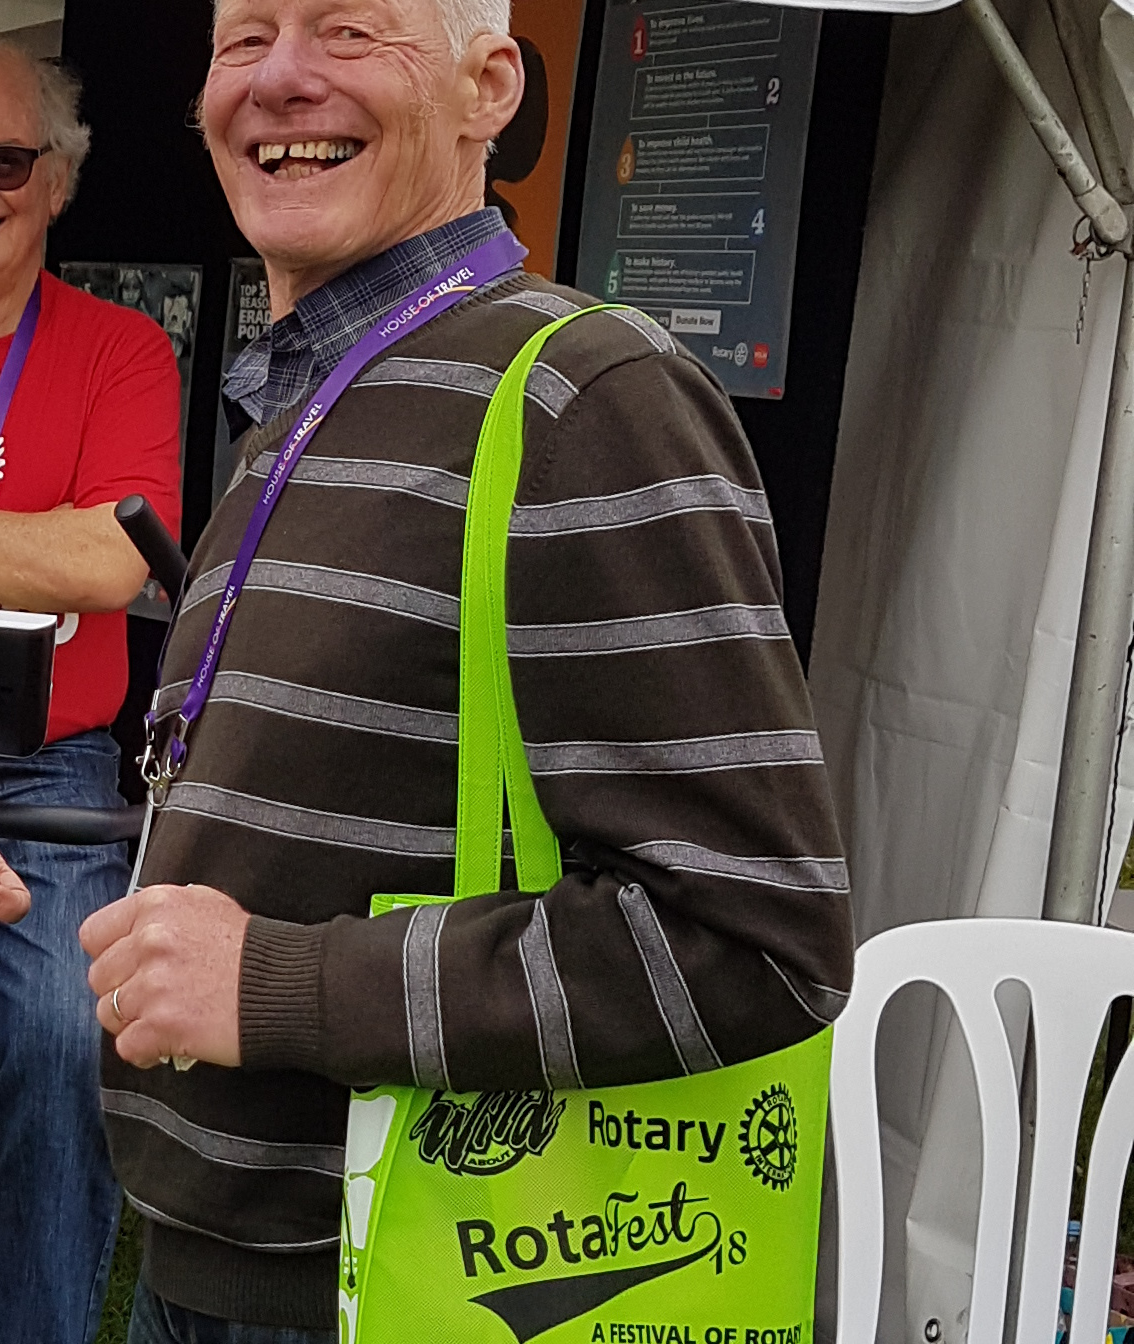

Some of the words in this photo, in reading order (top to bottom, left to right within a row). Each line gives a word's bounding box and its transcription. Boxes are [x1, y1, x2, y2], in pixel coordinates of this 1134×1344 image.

[634, 30, 644, 54] 1
[767, 77, 780, 104] 2
[621, 153, 631, 177] 3
[751, 208, 765, 235] 4
[240, 285, 257, 296] TOP
[259, 280, 267, 297] 5
[608, 270, 618, 294] 5
[239, 297, 269, 309] REASO
[379, 306, 419, 338] HOUSE
[417, 290, 436, 308] OF
[434, 267, 474, 296] TRAVEL
[239, 309, 272, 324] ERAD
[262, 462, 285, 505] HOUSE
[284, 441, 296, 461] OF
[293, 403, 322, 442] TRAVEL
[197, 646, 215, 688] HOUSE
[218, 585, 236, 626] TRAVEL
[589, 1100, 727, 1164] Rotary
[467, 1149, 511, 1167] ABOUT
[709, 1230, 747, 1276] 18
[591, 1322, 605, 1344] A
